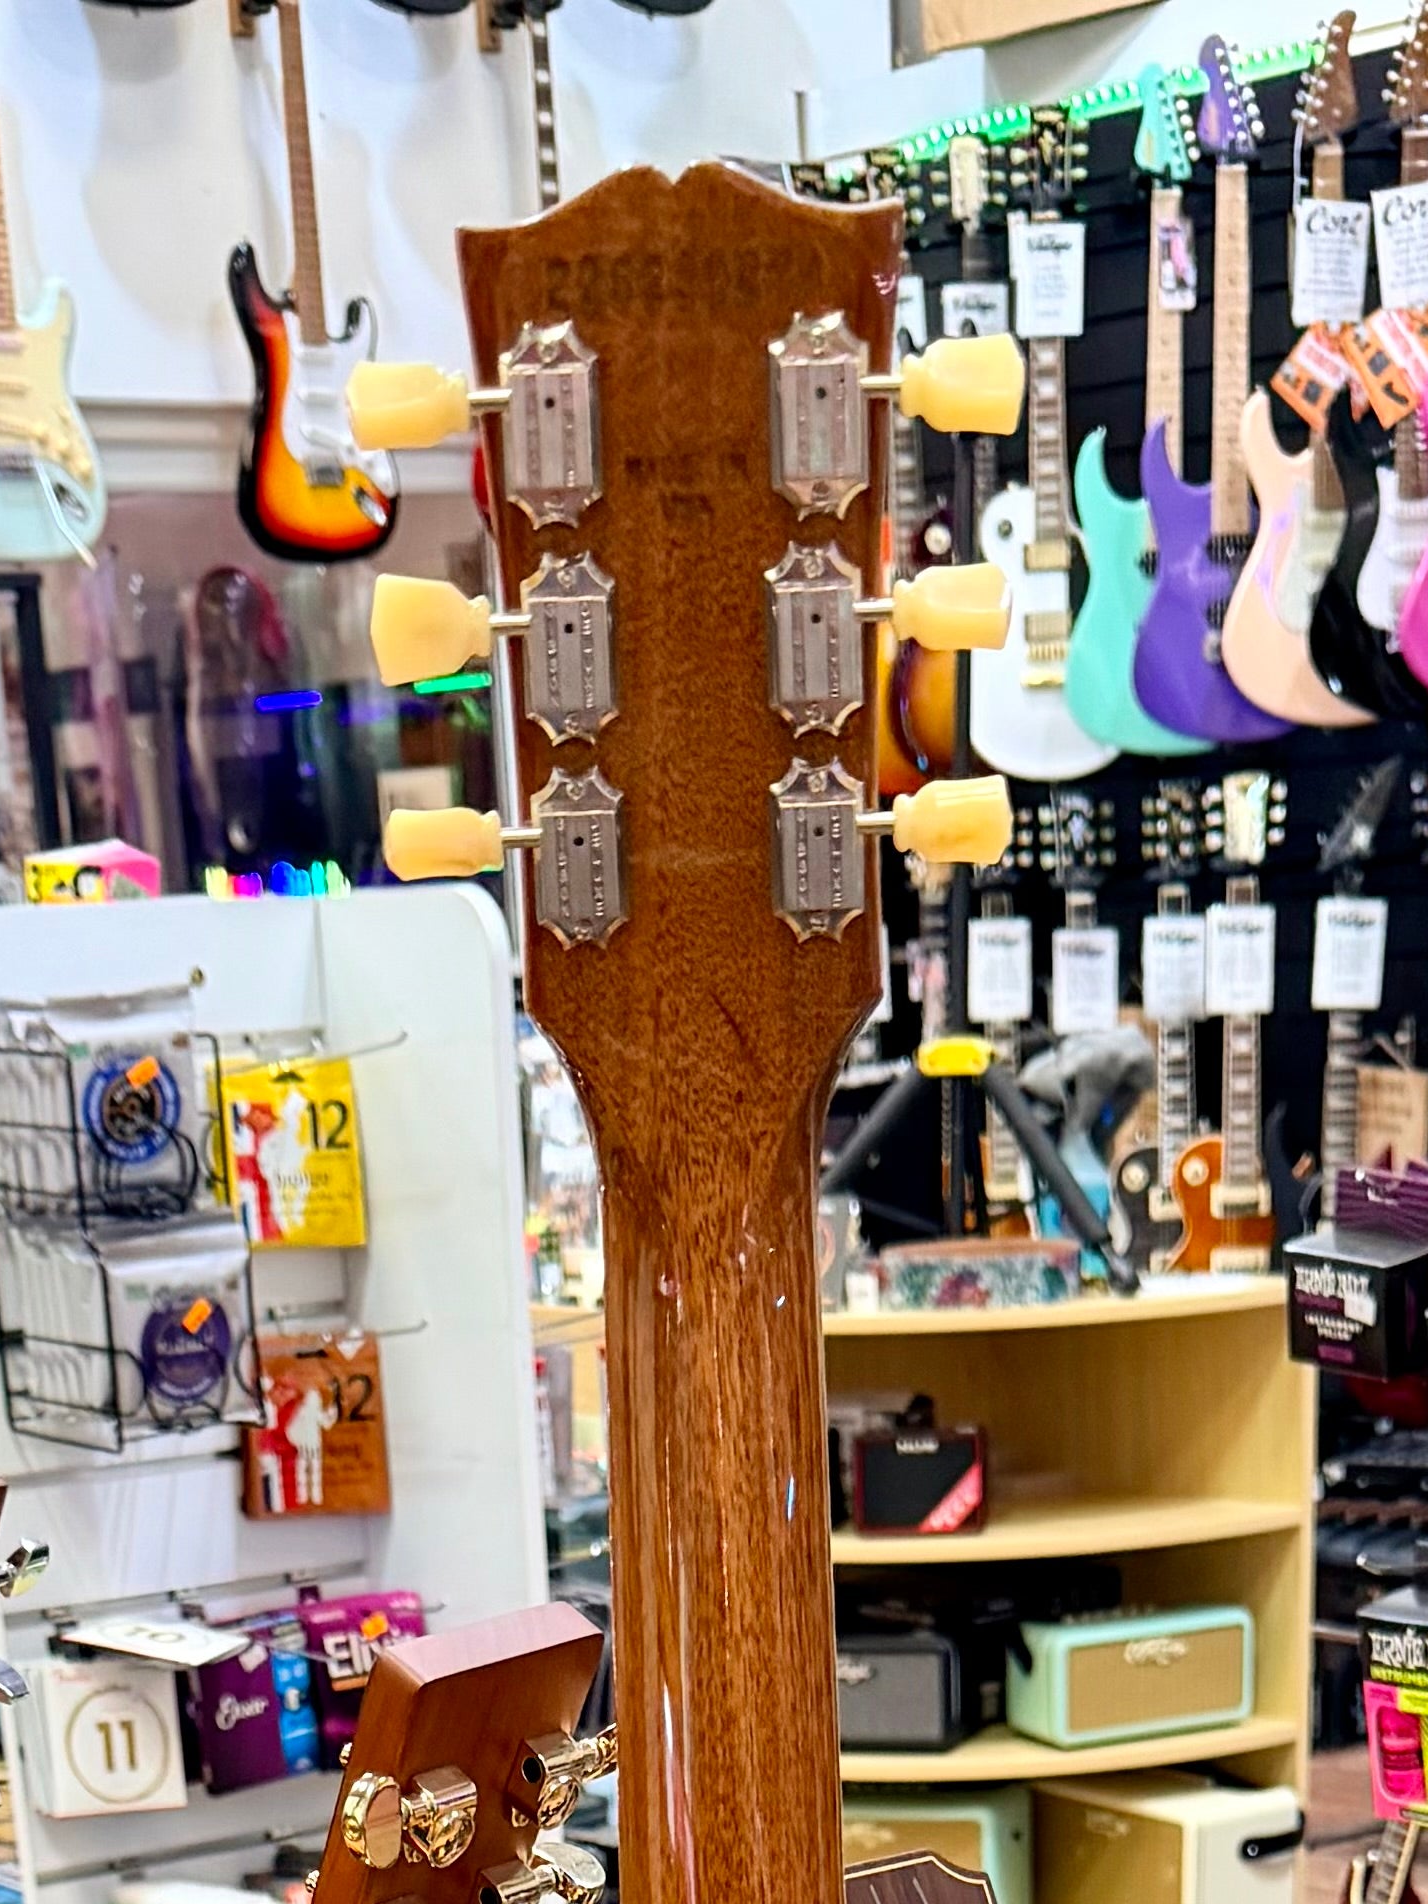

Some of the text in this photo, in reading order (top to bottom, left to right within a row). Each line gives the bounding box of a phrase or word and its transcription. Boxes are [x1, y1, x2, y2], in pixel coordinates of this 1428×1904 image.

[1305, 205, 1363, 237] Cort
[308, 1099, 351, 1150] 12
[1368, 1627, 1423, 1668] ERNIE
[94, 1720, 137, 1773] 11
